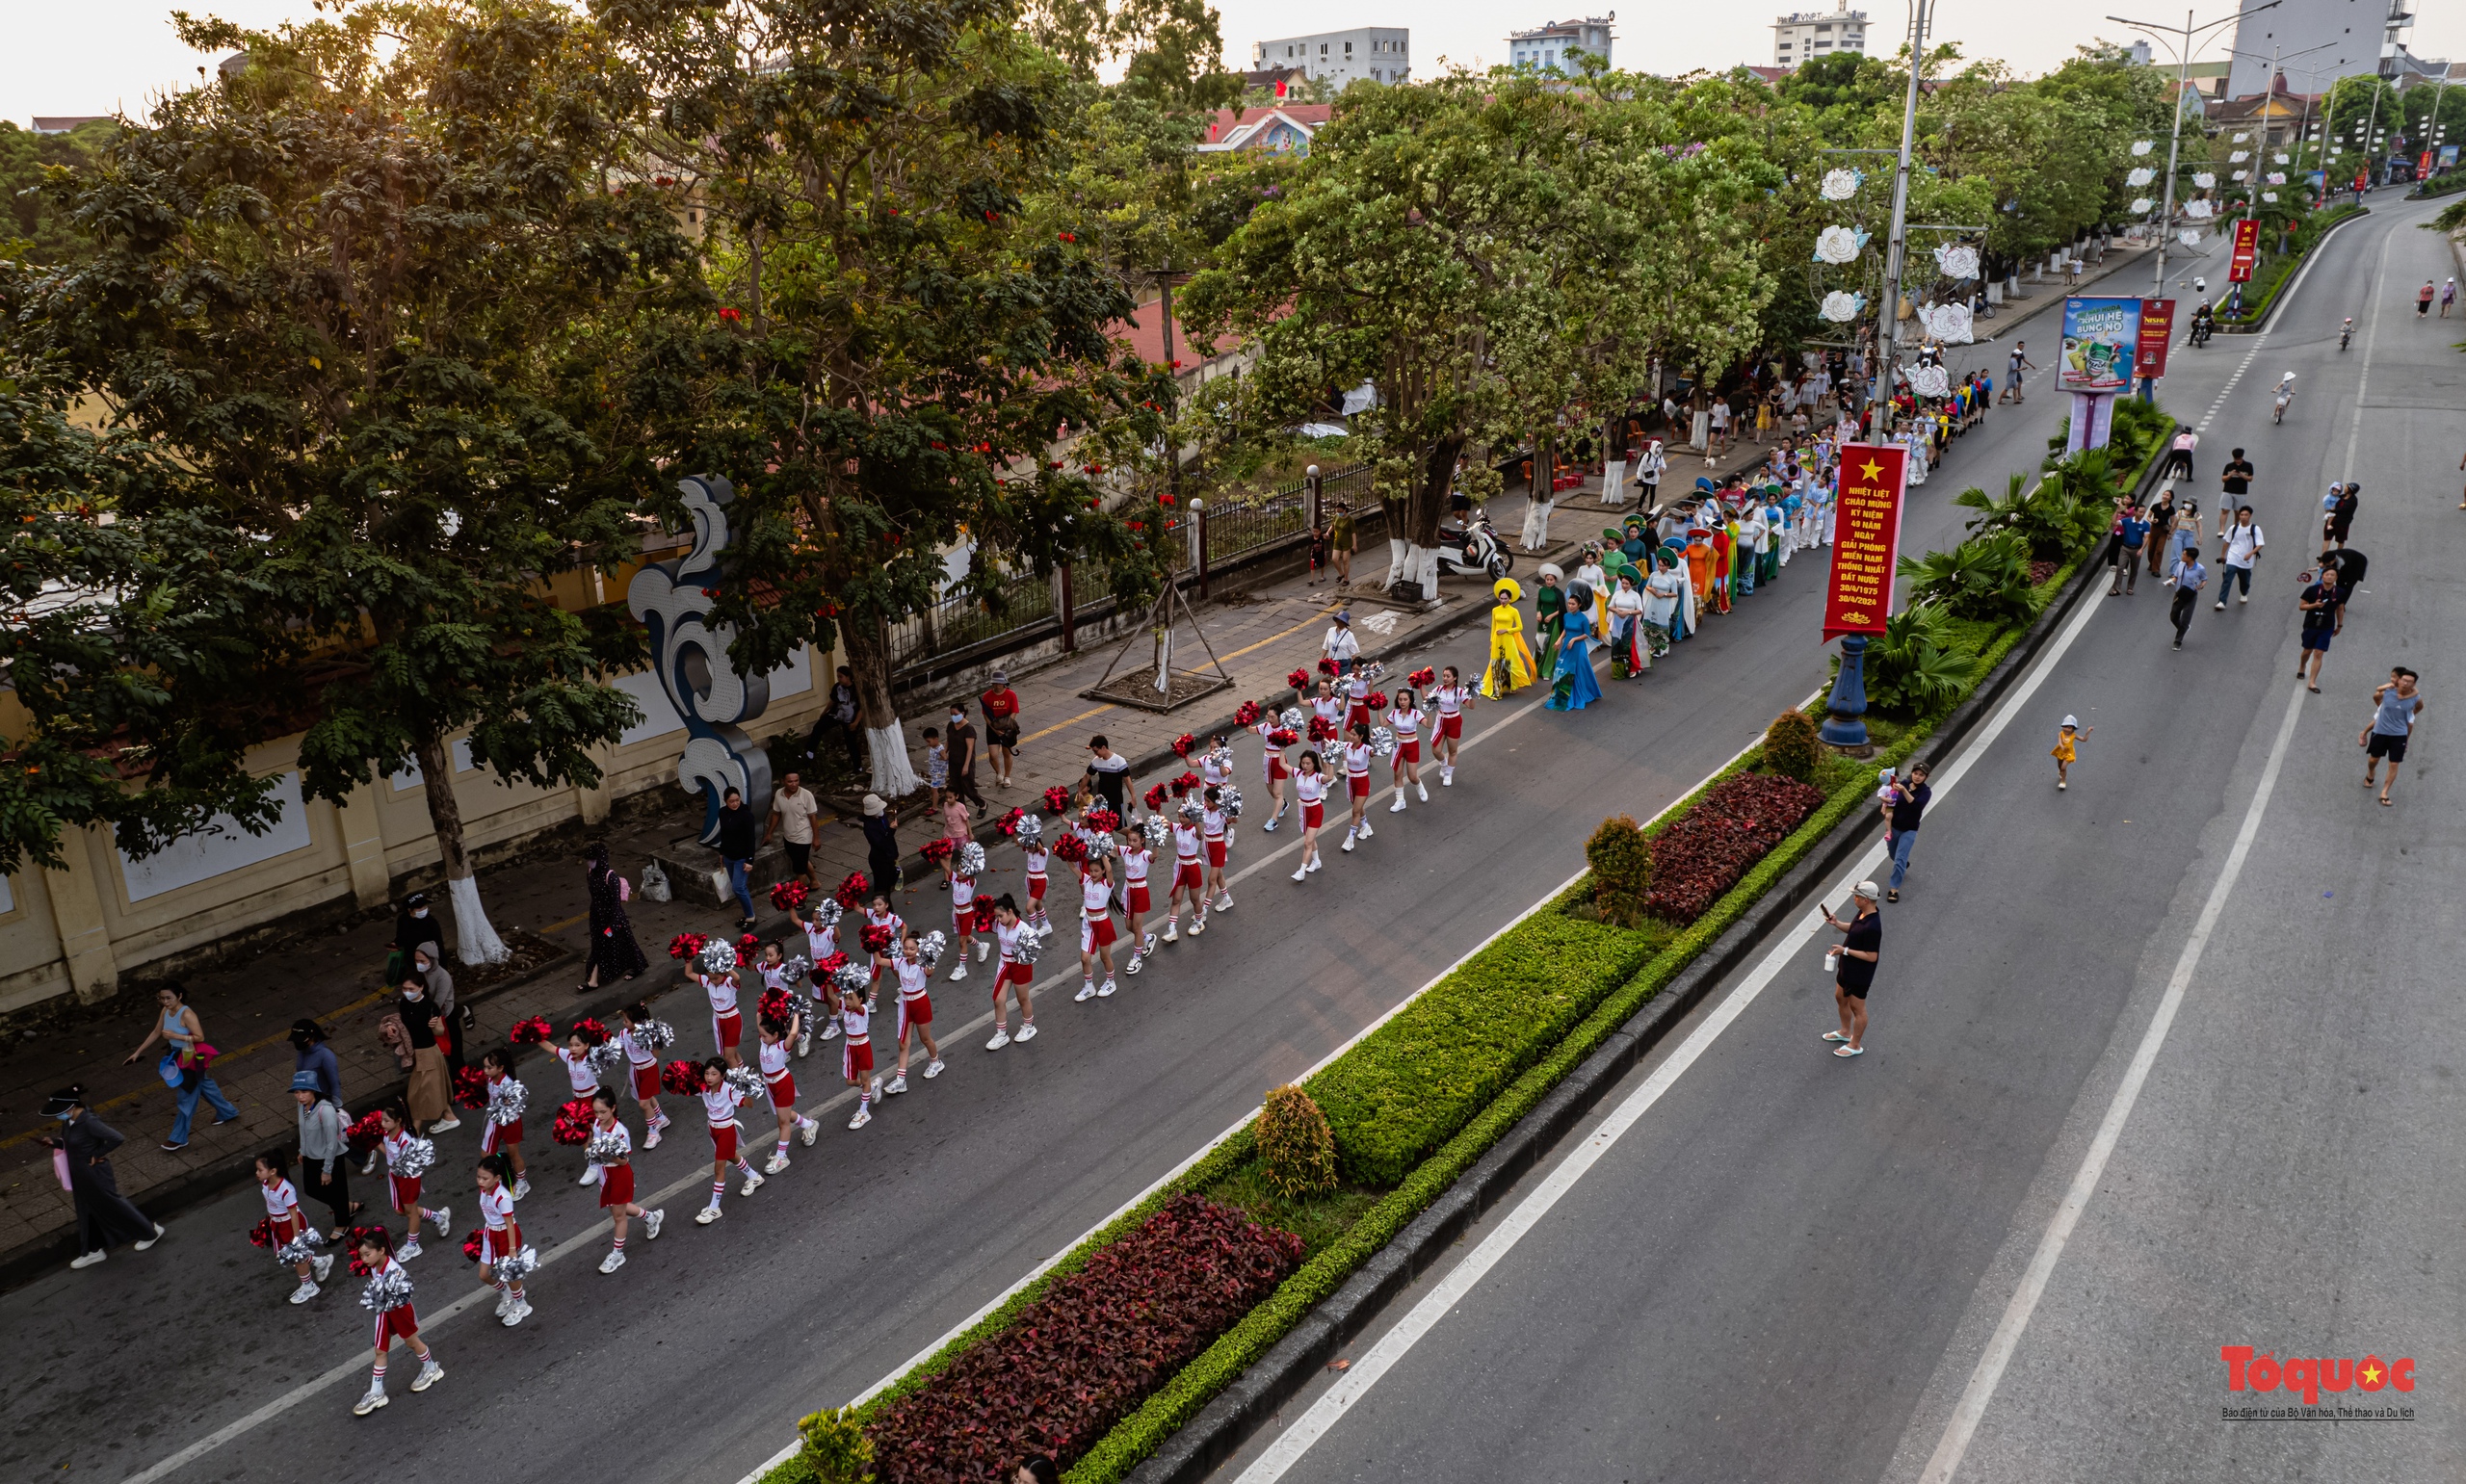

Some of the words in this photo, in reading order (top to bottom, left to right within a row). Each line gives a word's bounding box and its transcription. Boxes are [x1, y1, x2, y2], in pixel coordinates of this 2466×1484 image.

[1849, 486, 1872, 497] NHIỆT
[1873, 488, 1890, 499] LIỆT
[1862, 510, 1884, 520] NIỆM
[1853, 531, 1876, 540] NGÀY
[1841, 538, 1857, 549] GIẢI
[1858, 542, 1886, 552] PHÓNG
[1864, 554, 1883, 562] NAM
[1837, 560, 1863, 572] THỐNG
[1864, 563, 1886, 574] NHẤT
[1839, 584, 1878, 595] 30/4/1975
[1838, 594, 1877, 606] 30/4/2024
